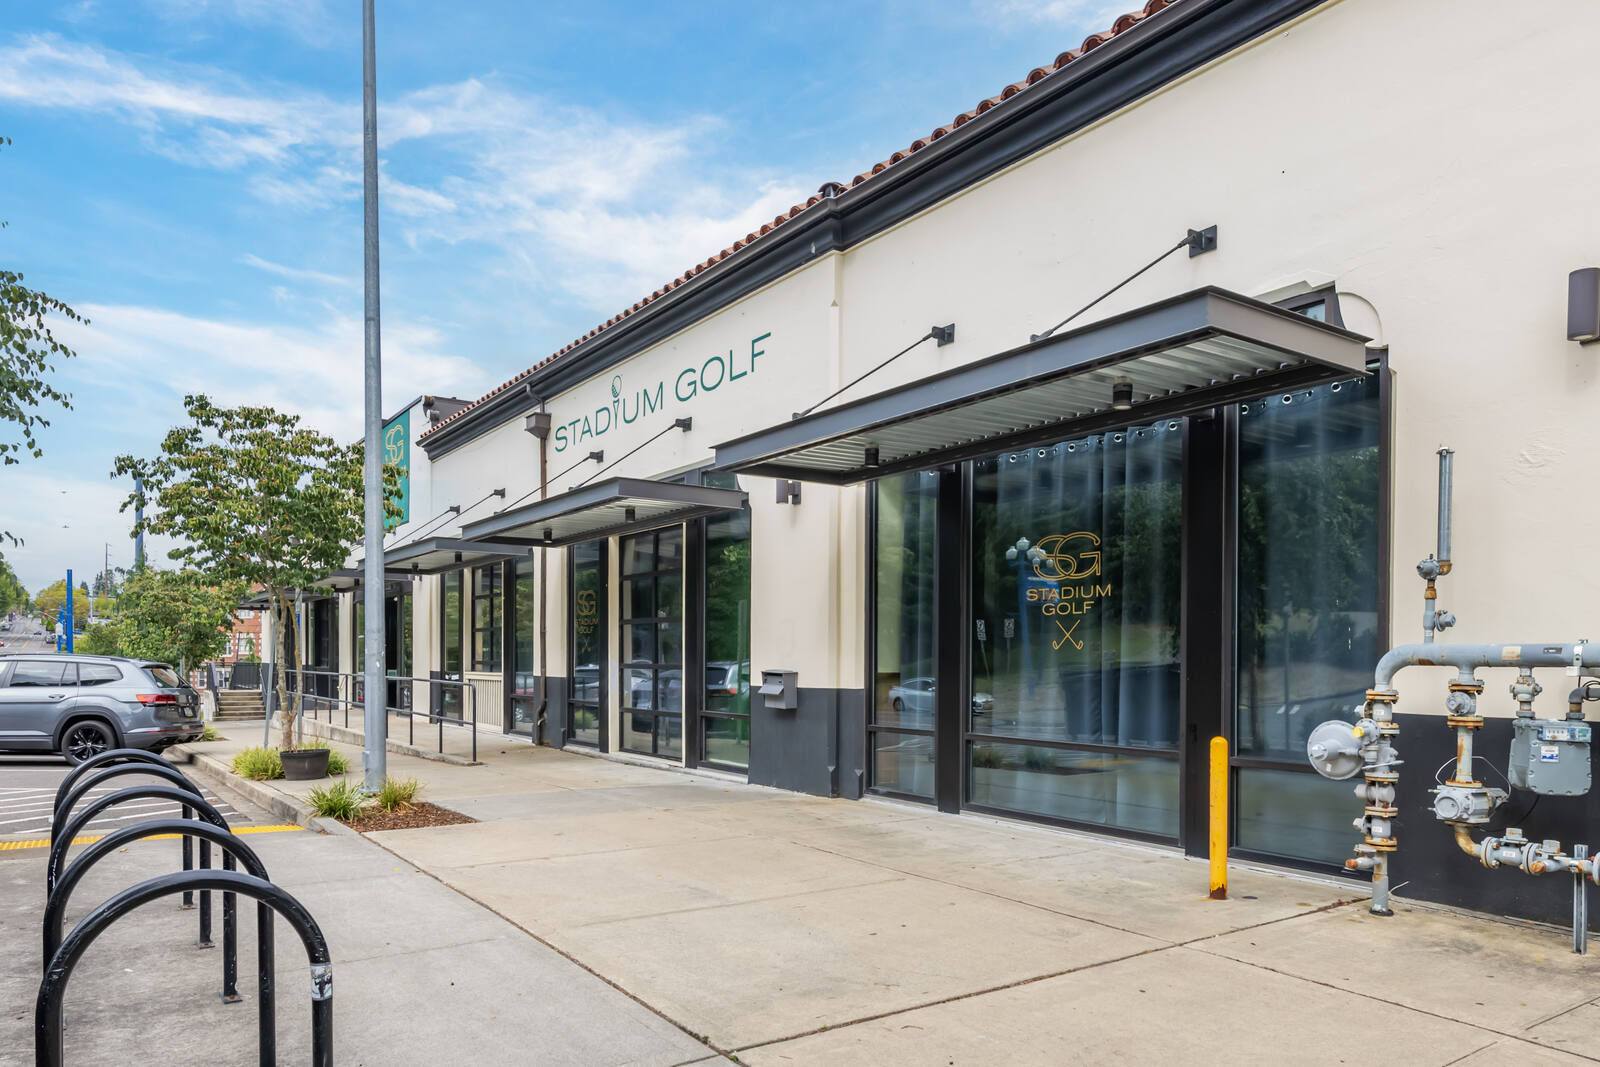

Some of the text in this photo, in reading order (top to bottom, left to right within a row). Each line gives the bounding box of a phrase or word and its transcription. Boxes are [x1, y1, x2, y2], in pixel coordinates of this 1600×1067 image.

[555, 332, 771, 453] STADIUM GOLF
[1033, 531, 1101, 581] SG
[576, 590, 597, 616] SG
[1026, 584, 1111, 602] STADIUM
[1042, 601, 1094, 616] GOLF
